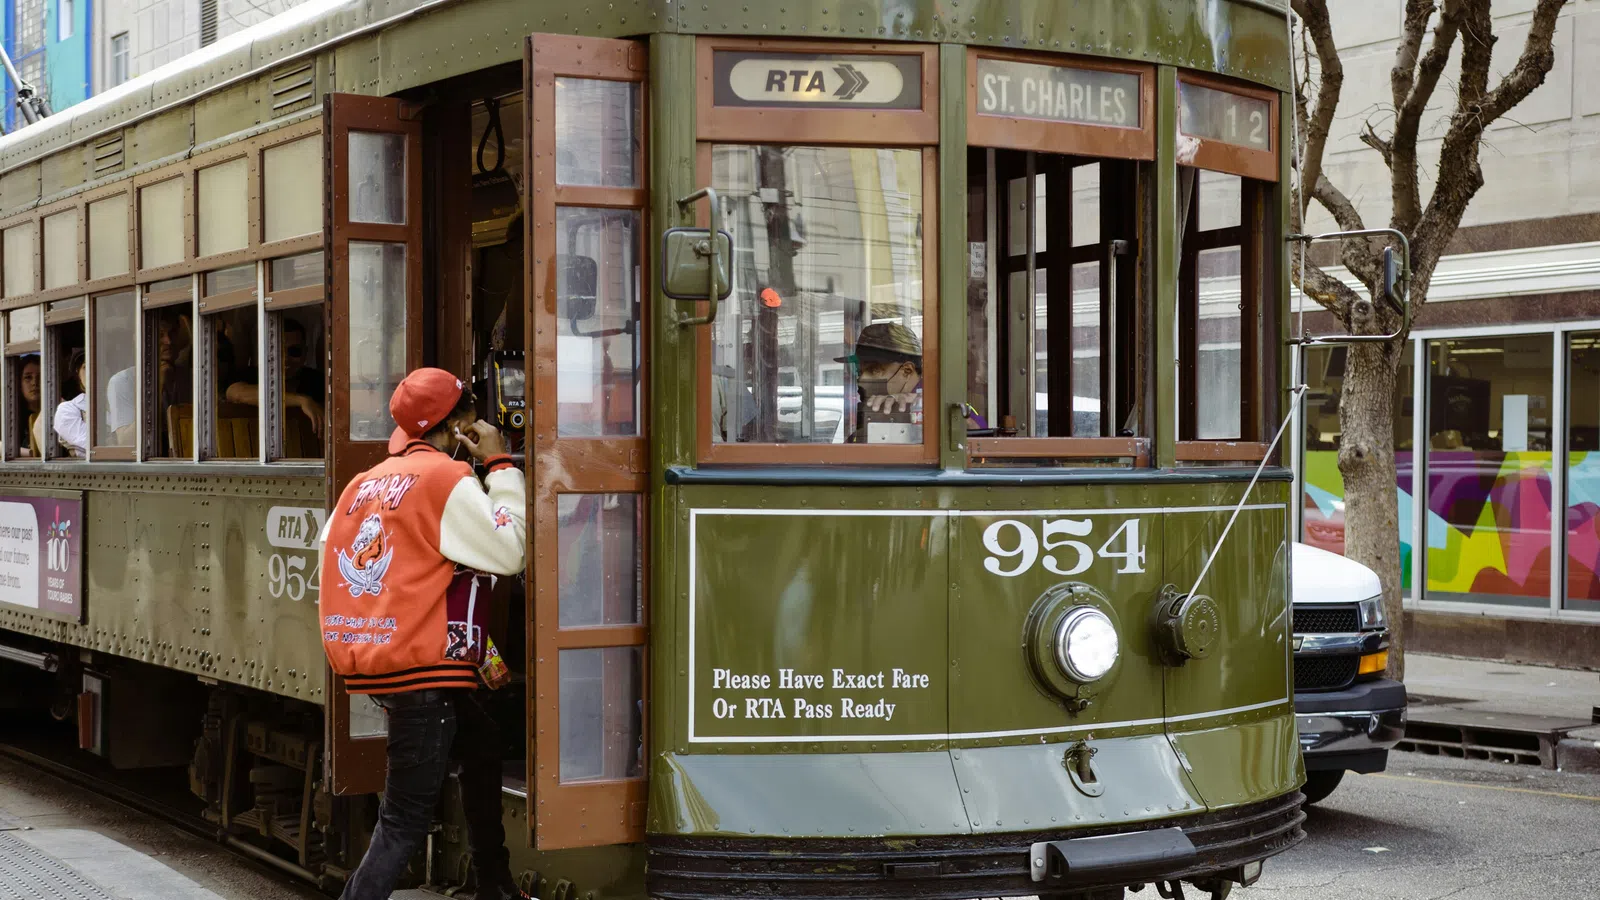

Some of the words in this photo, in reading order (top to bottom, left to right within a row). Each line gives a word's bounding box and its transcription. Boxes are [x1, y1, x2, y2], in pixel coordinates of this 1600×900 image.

[765, 69, 826, 93] RTA
[982, 73, 1015, 113] ST.
[1021, 77, 1126, 124] CHARLES
[381, 472, 420, 511] BAY
[11, 526, 21, 540] our
[21, 525, 34, 544] past
[278, 515, 302, 540] RTA
[46, 537, 70, 572] 100
[982, 518, 1146, 577] 954
[345, 616, 367, 629] WHAT
[712, 668, 772, 689] Please
[778, 668, 824, 689] Have
[831, 668, 885, 689] Exact
[891, 668, 930, 689] Fare
[712, 698, 738, 719] Or
[744, 698, 786, 719] RTA
[793, 698, 833, 719] Pass
[840, 698, 896, 721] Ready
